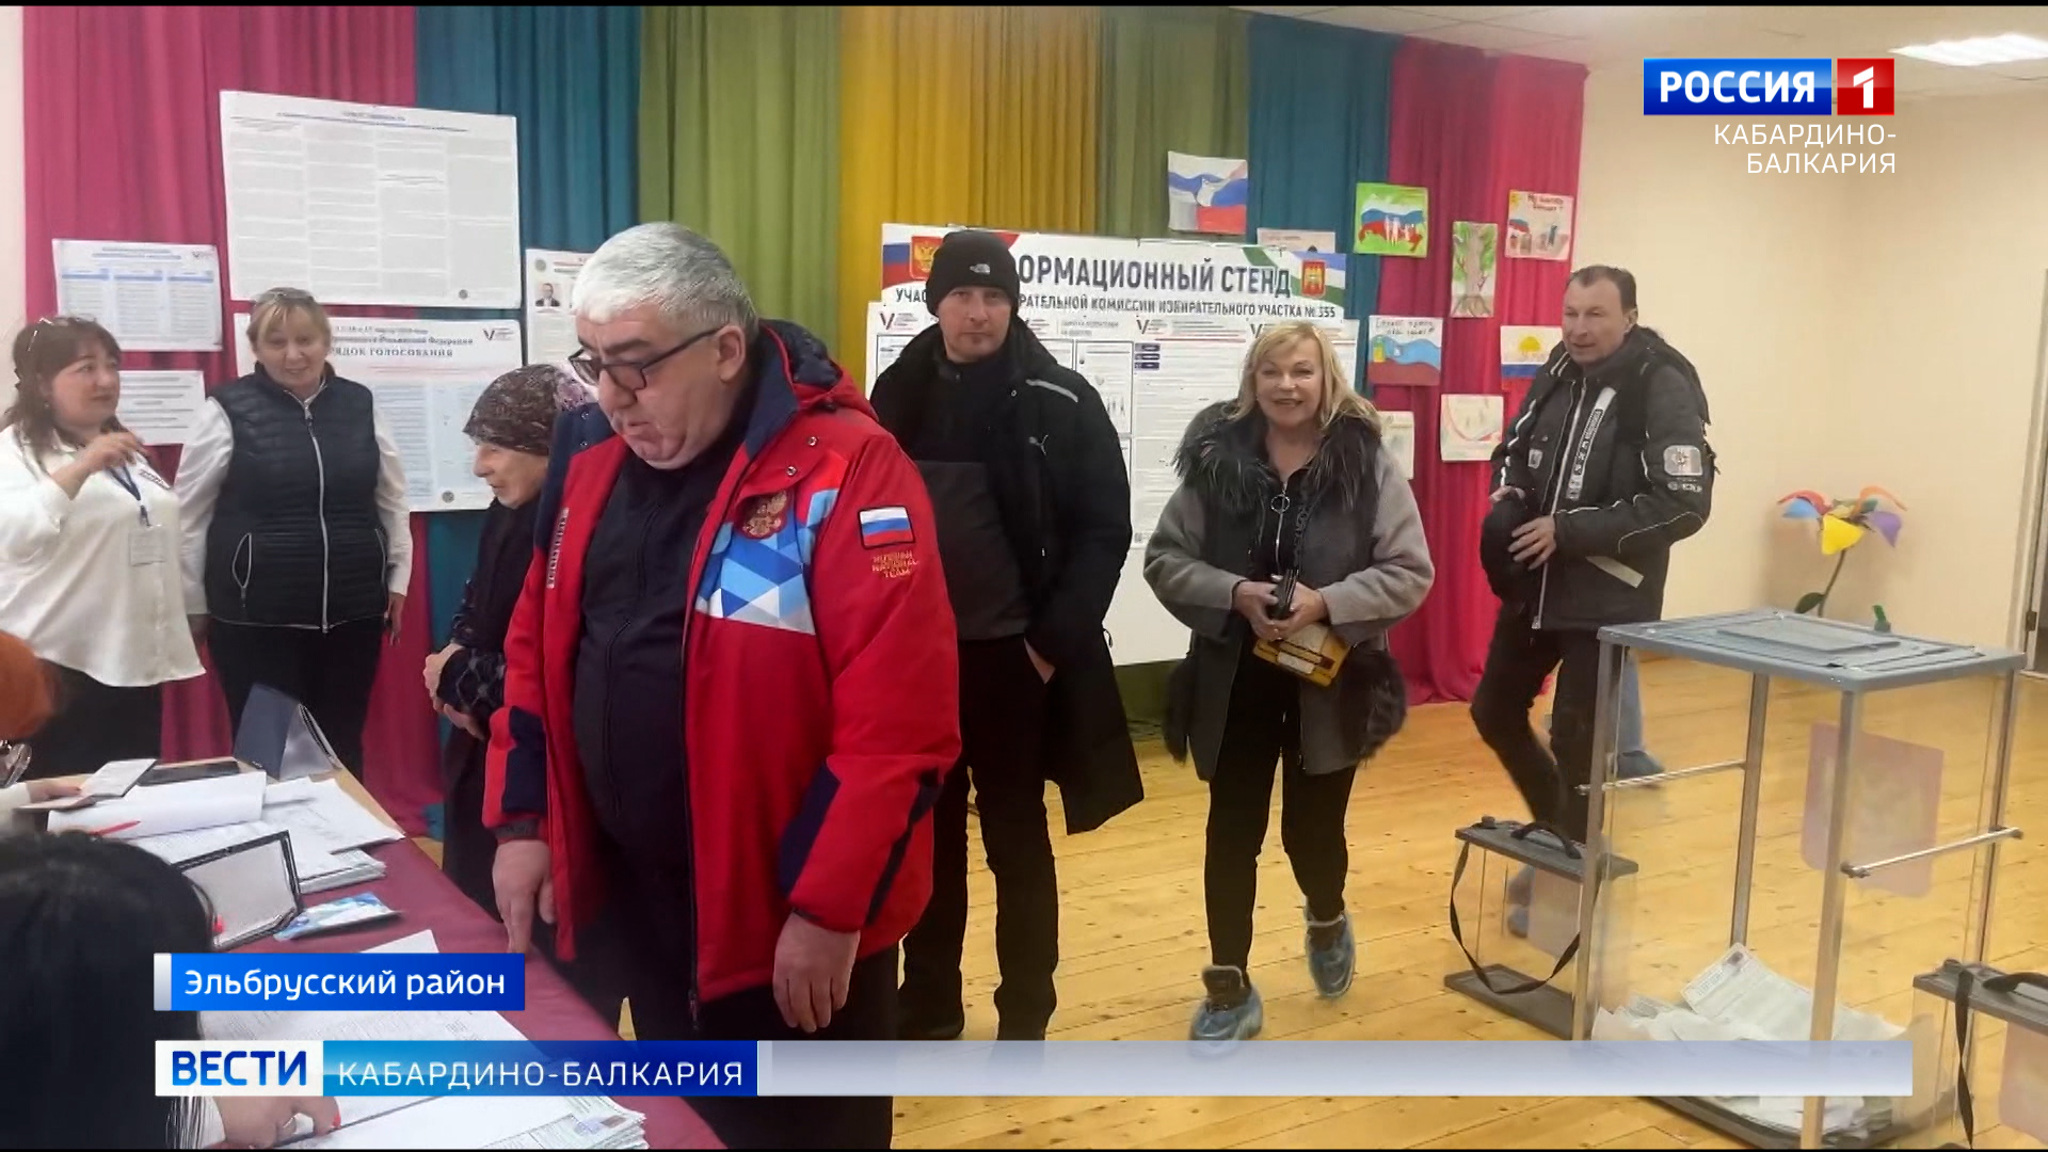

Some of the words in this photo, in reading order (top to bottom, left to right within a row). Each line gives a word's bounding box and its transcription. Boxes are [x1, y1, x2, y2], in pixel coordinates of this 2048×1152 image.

[1018, 254, 1214, 292] ОРМАЦИОННЫЙ
[1221, 265, 1291, 298] СТЕНД
[896, 287, 927, 303] УЧАС
[1018, 293, 1088, 309] РАТЕЛЬНОЙ
[1091, 297, 1155, 314] КОМИССИИ
[1158, 301, 1255, 316] ИЗБИРАТЕЛЬНОГО
[1258, 304, 1302, 318] УЧАСТКА
